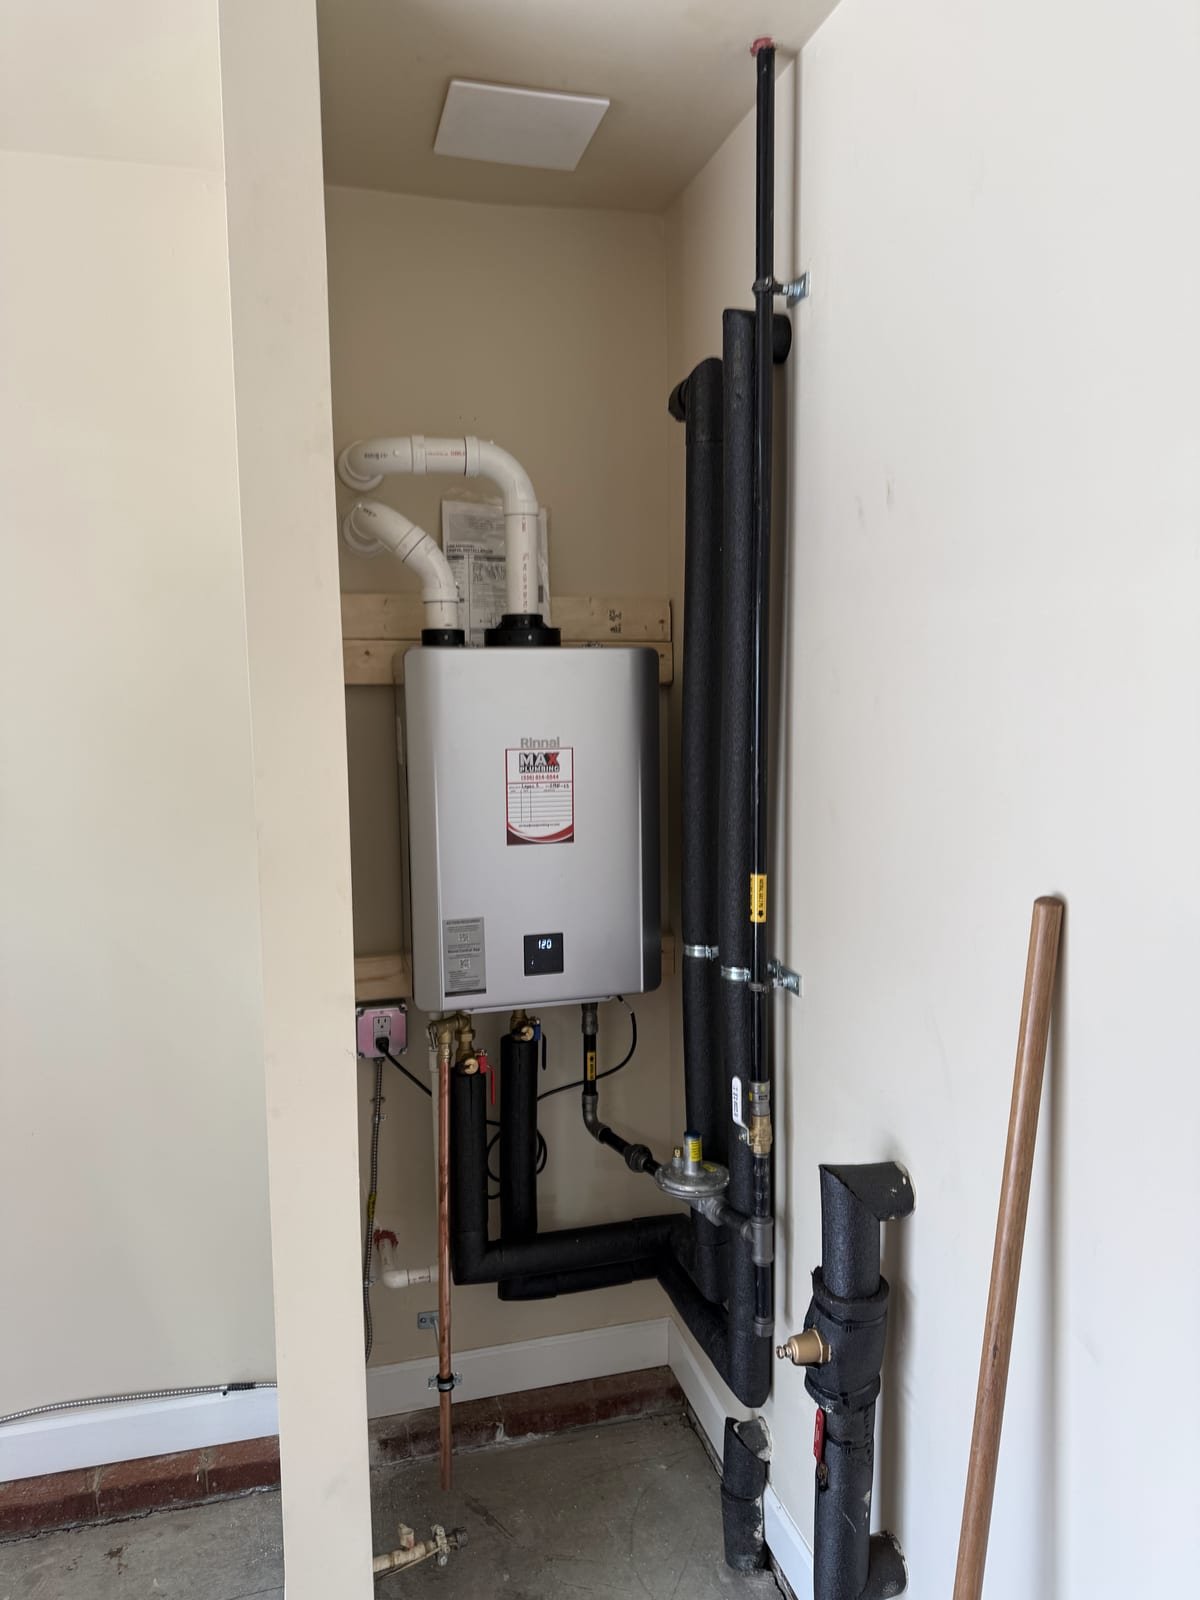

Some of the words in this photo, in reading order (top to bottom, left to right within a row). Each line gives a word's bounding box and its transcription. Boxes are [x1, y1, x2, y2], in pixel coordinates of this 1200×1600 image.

[519, 752, 560, 767] MAX
[519, 765, 560, 774] PLUMBING
[538, 938, 552, 950] 120
